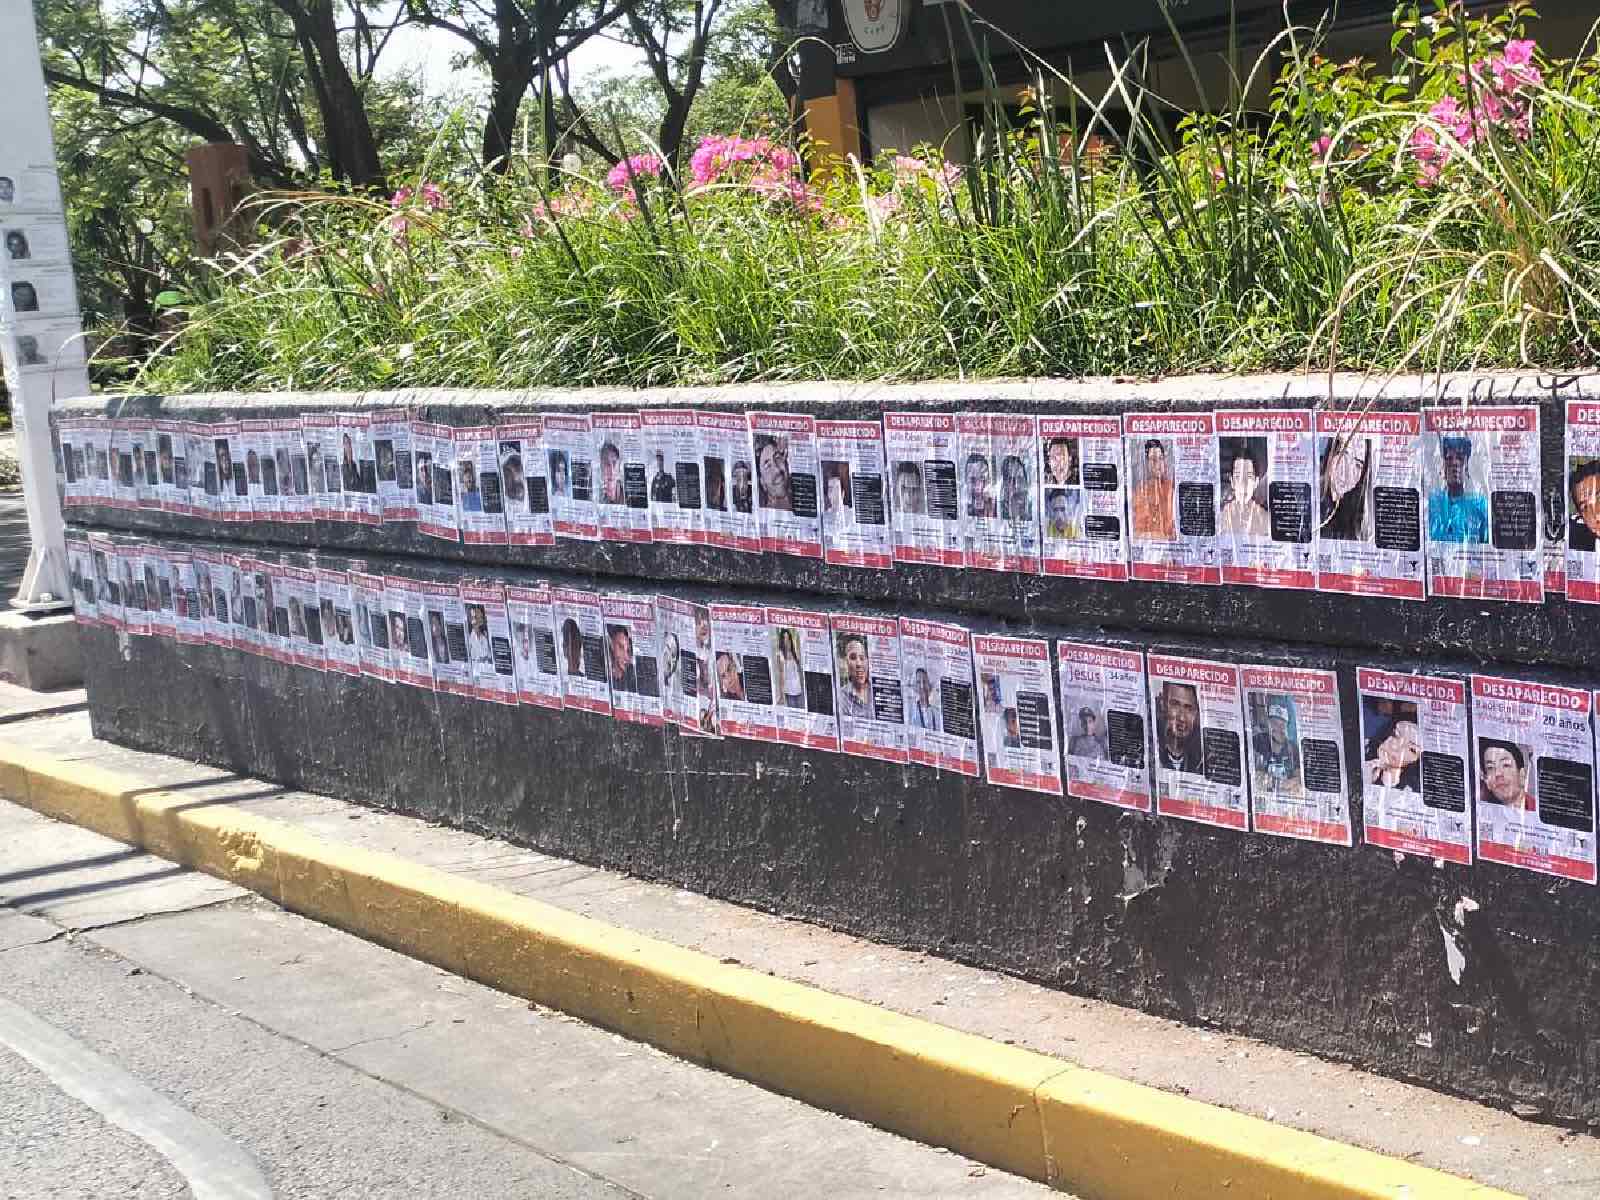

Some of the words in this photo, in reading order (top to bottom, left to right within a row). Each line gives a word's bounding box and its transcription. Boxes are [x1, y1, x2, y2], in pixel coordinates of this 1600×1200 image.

[1132, 420, 1206, 432] DESAPARECIDO
[1222, 416, 1304, 429] DESAPARECIDO
[1431, 415, 1526, 429] DESAPARECIDO
[1066, 650, 1136, 669] DESAPARECIDO
[1156, 663, 1229, 683] DESAPARECIDO
[1249, 674, 1325, 691] DESAPARECIDO
[1367, 675, 1456, 700] DESAPARECIDA
[1482, 682, 1581, 708] DESAPARECIDO
[1543, 715, 1556, 726] 20
